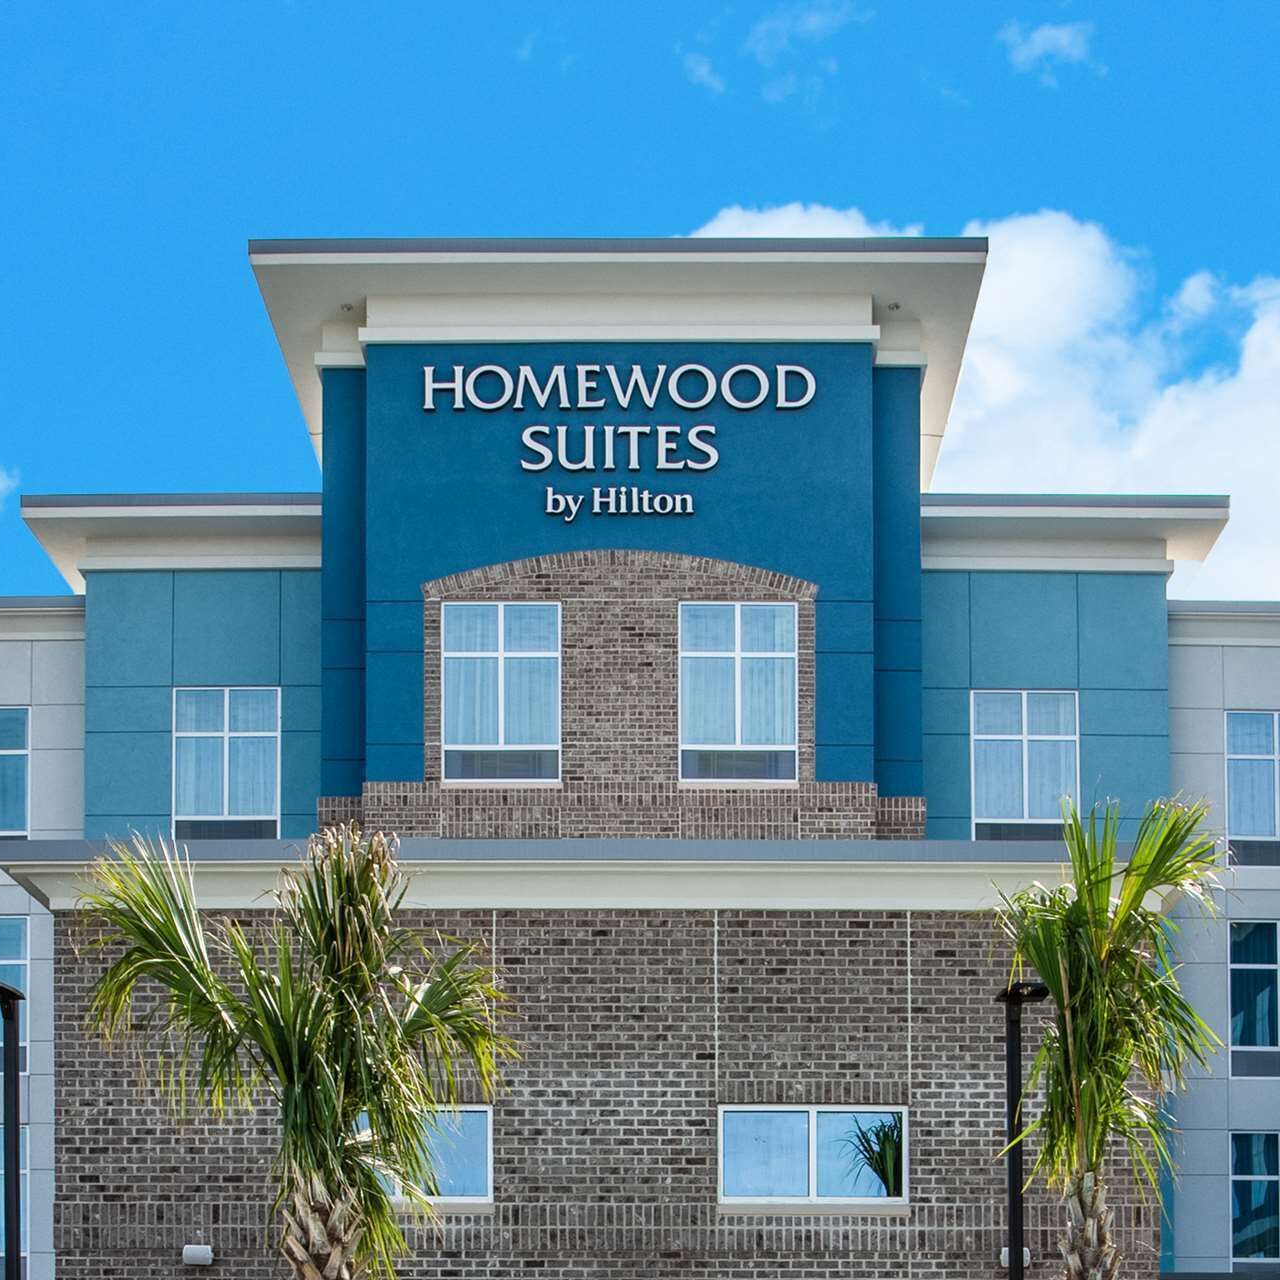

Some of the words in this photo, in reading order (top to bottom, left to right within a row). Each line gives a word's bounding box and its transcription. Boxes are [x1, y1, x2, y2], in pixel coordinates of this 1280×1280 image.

[422, 364, 817, 410] HOMEWOOD
[520, 424, 720, 471] SUITES
[545, 487, 584, 522] by
[592, 487, 695, 514] Hilton
